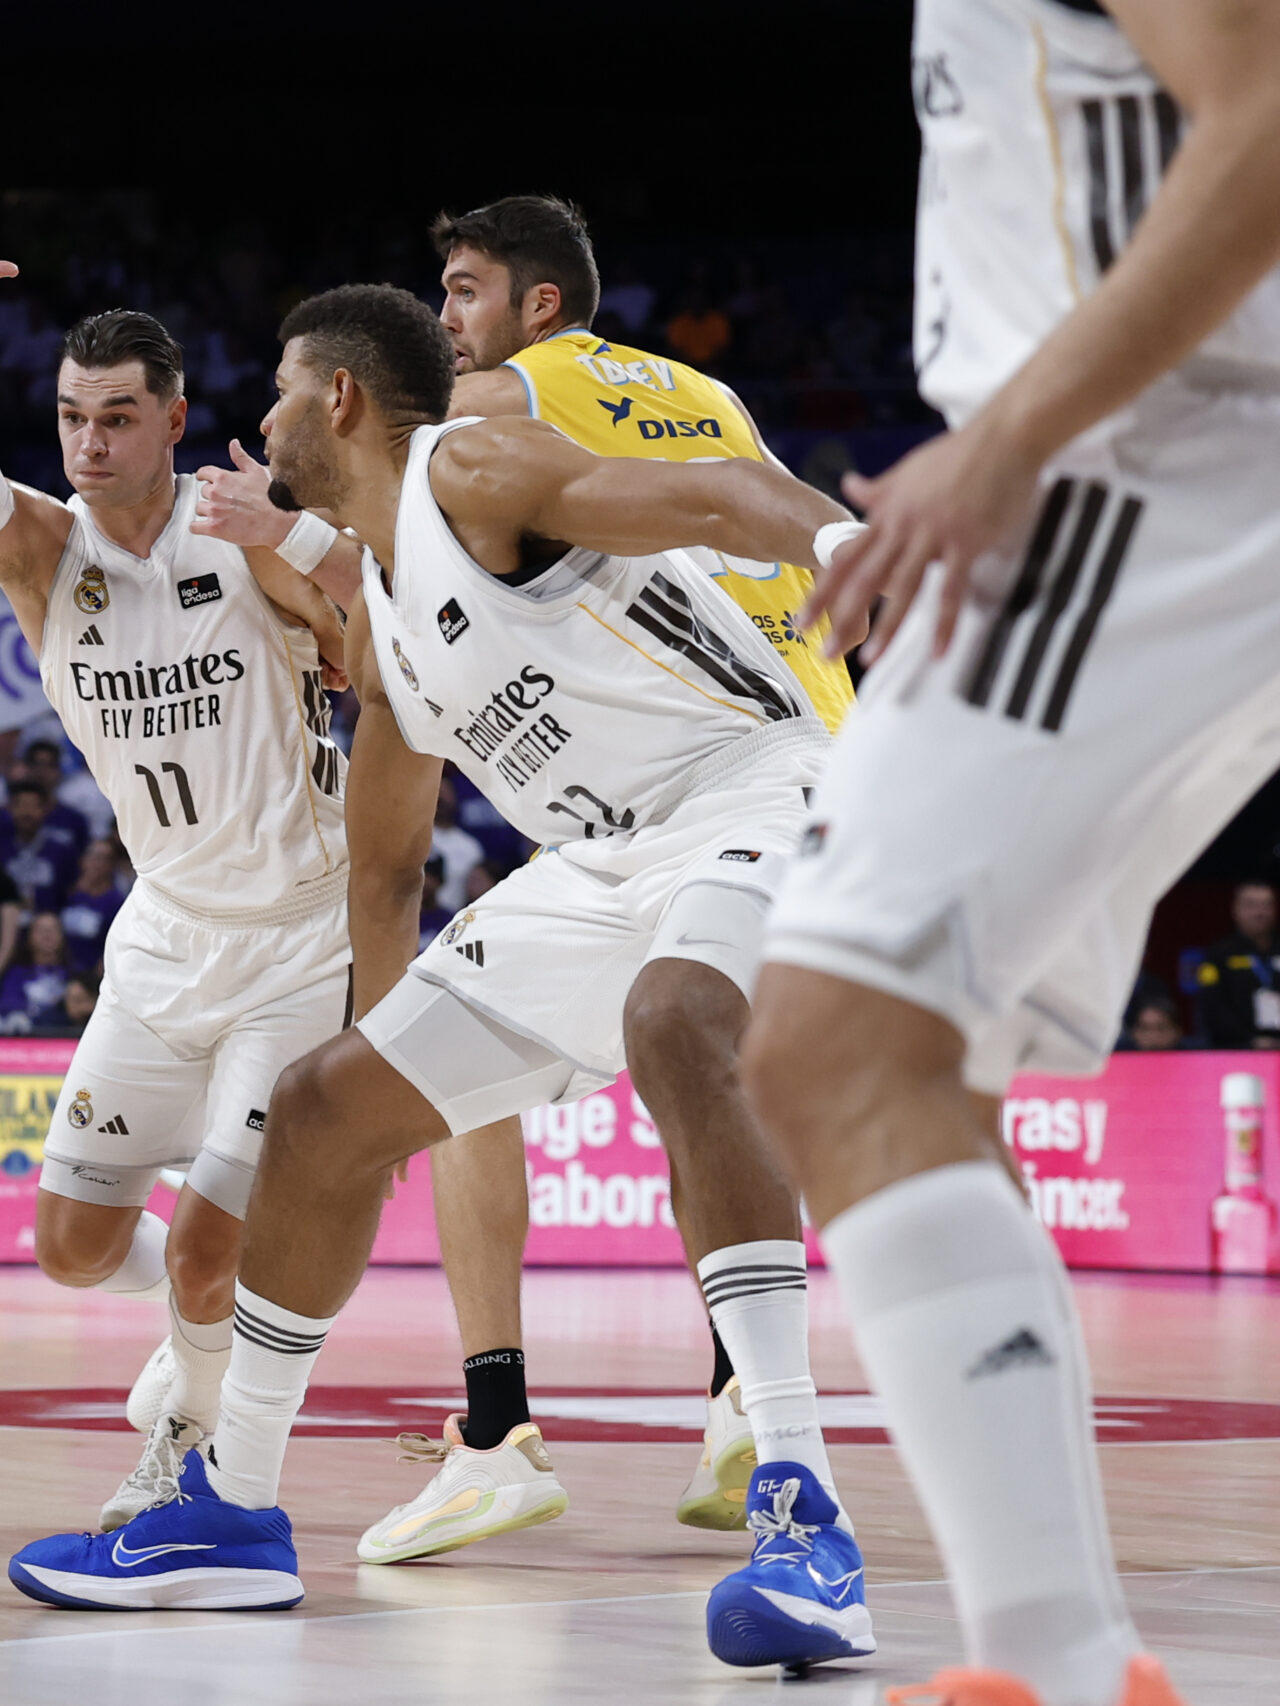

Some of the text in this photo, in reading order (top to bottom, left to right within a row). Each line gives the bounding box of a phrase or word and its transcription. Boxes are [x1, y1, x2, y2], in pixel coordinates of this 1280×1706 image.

[69, 649, 246, 701] Emirates
[100, 693, 222, 739] FLY BETTER
[453, 664, 556, 763] Emirates
[134, 761, 199, 828] 11
[248, 1117, 266, 1130] ac
